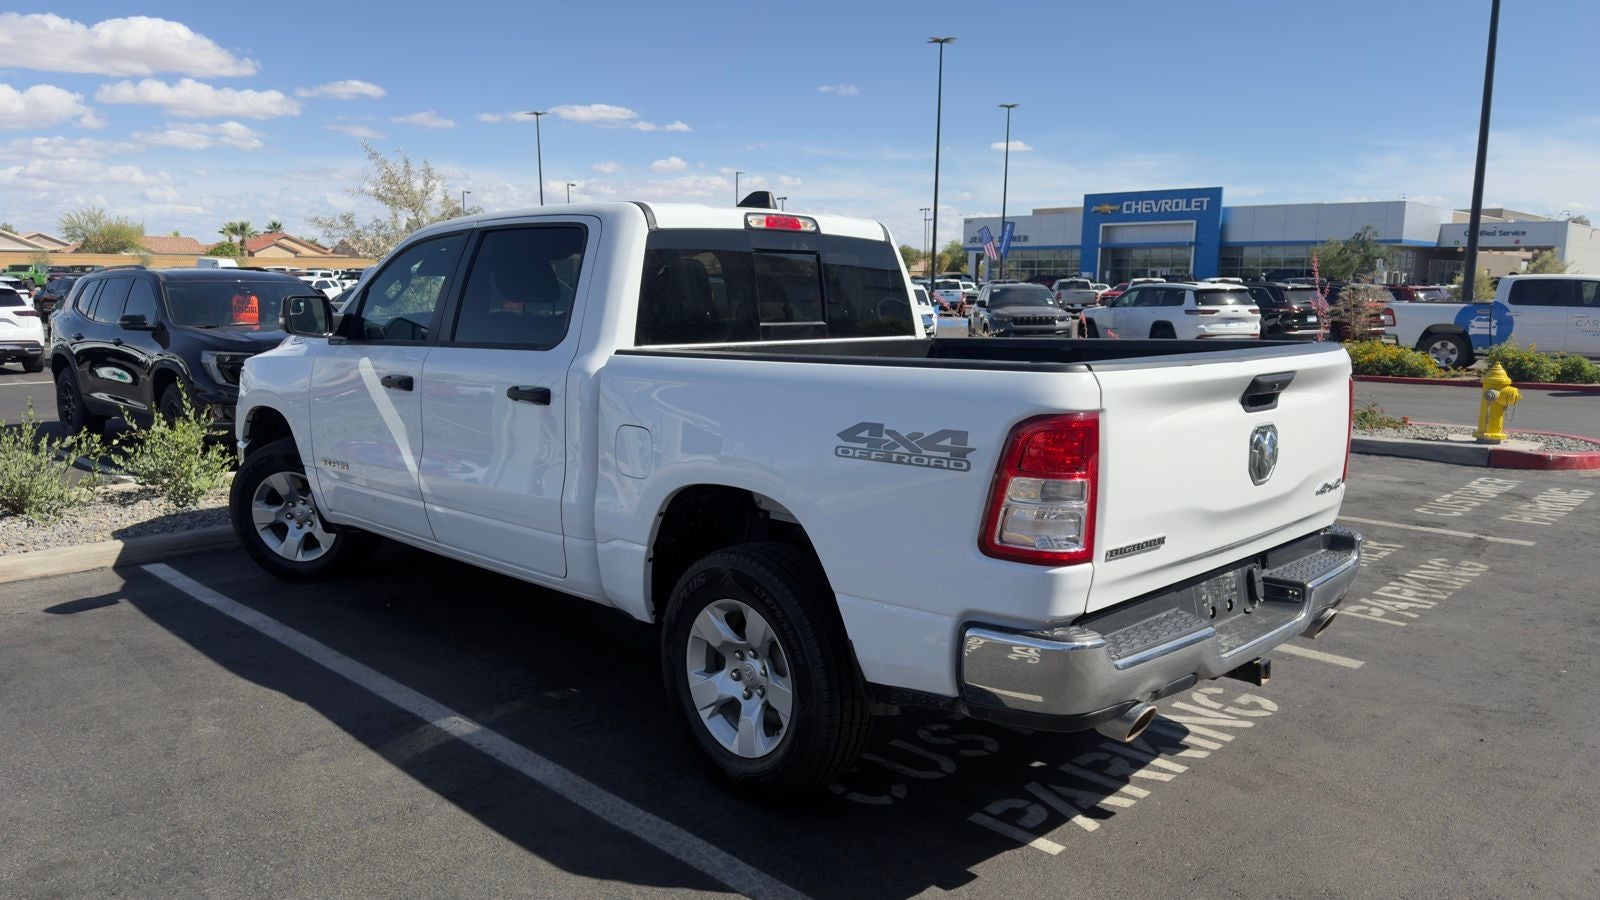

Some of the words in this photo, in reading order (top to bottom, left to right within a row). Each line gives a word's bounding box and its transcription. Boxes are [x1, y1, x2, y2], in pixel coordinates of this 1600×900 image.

[1122, 198, 1210, 214] CHEVROLET
[1498, 229, 1527, 237] Service
[837, 447, 886, 460] OFF
[891, 453, 969, 470] ROAD
[1414, 477, 1524, 517] CUSTOMER
[1500, 487, 1595, 526] PARKING
[1337, 557, 1490, 627] PARKING
[965, 686, 1279, 856] PARKING
